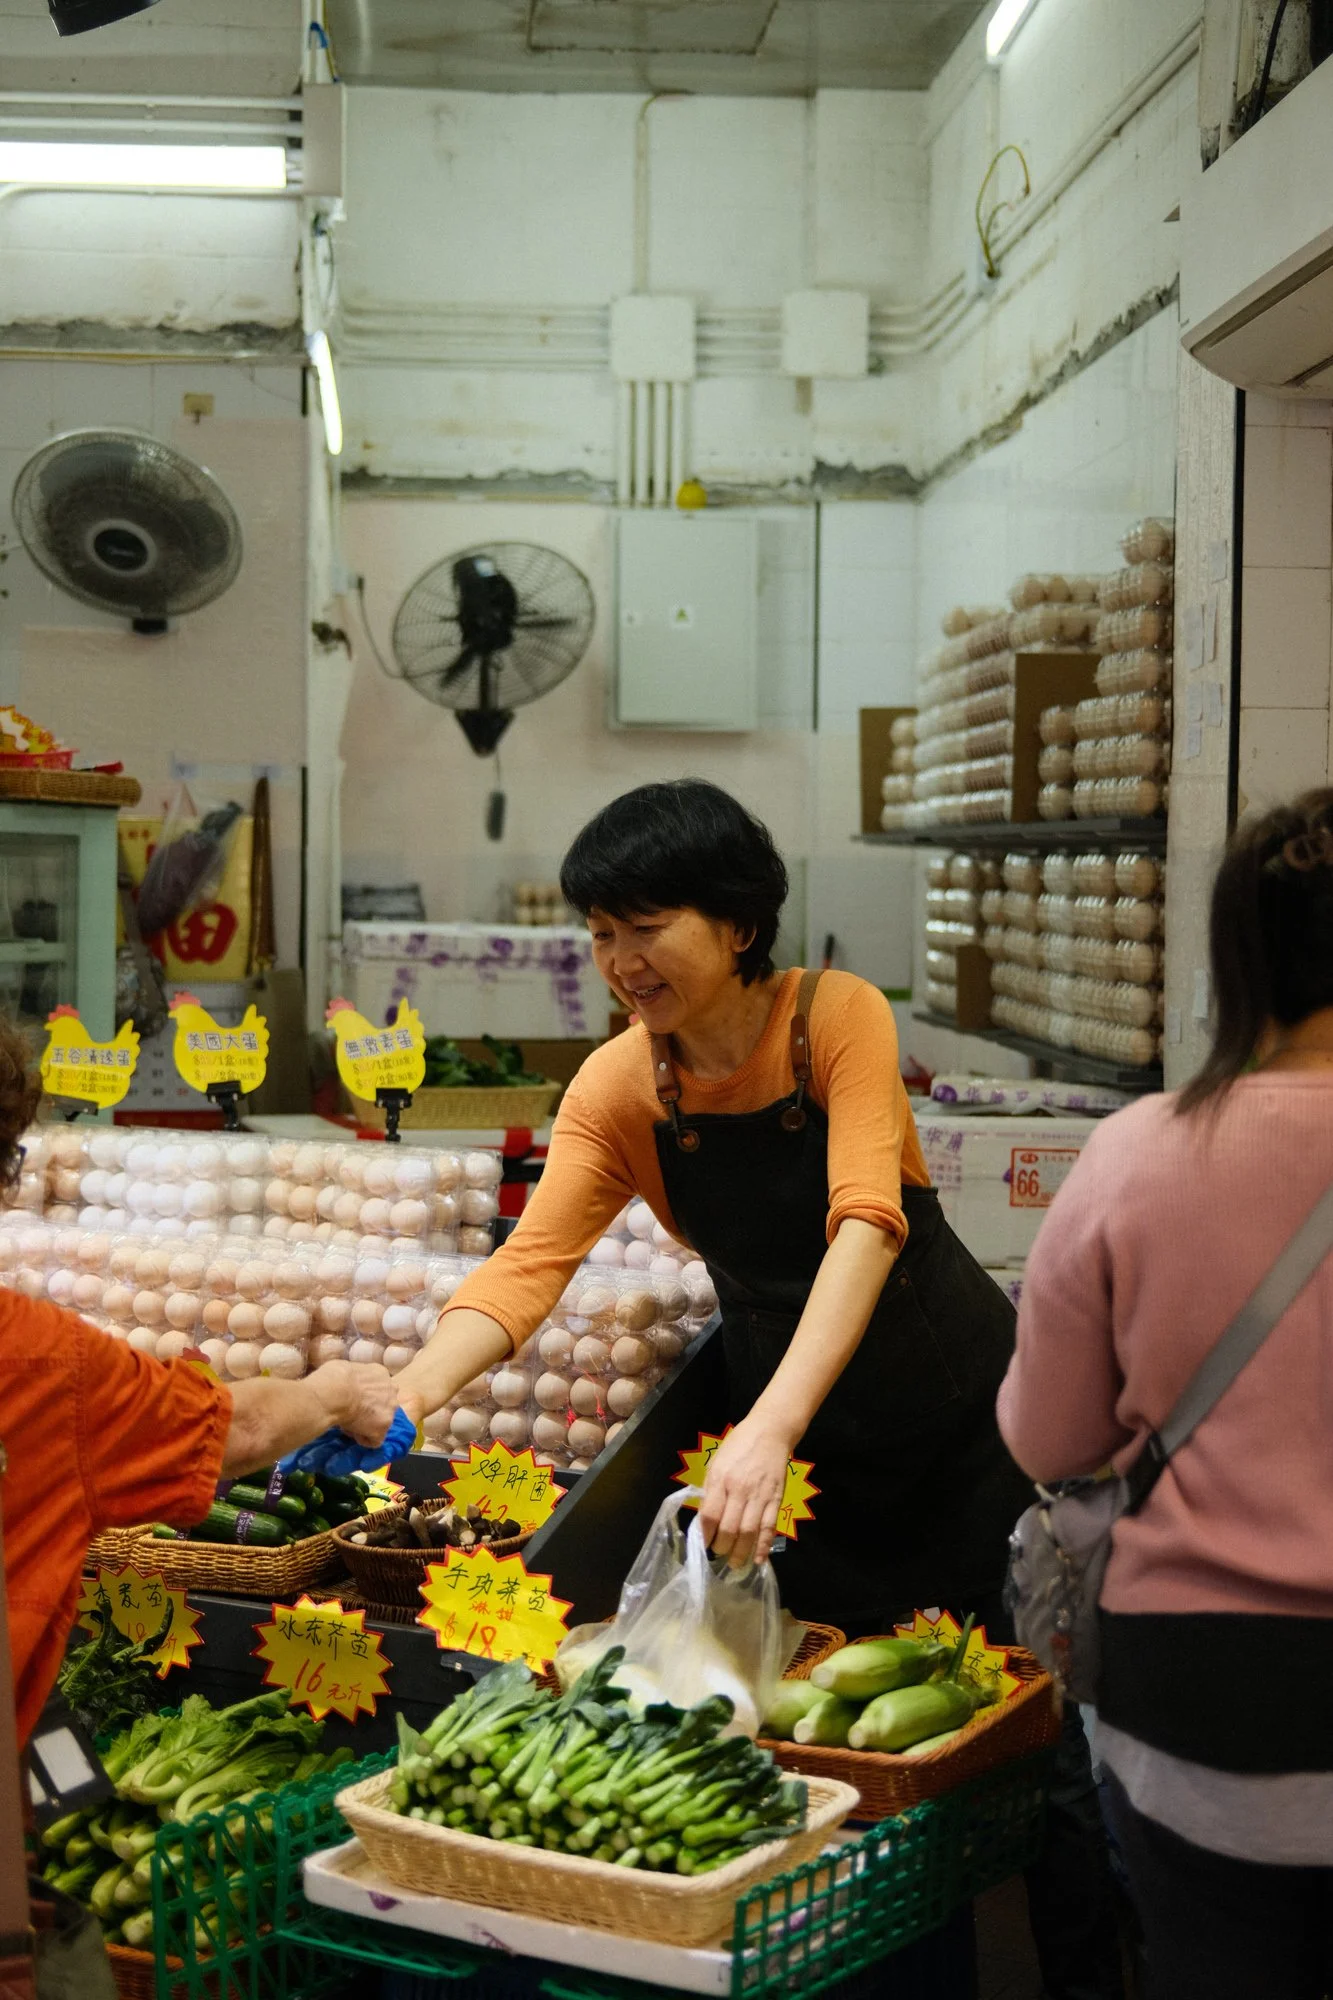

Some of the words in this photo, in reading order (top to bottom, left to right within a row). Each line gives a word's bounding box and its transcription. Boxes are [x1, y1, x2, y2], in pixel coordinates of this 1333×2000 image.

[187, 1032, 258, 1051] 美國大蛋
[344, 1028, 414, 1059] 無激素蛋
[1017, 1169, 1040, 1197] 66
